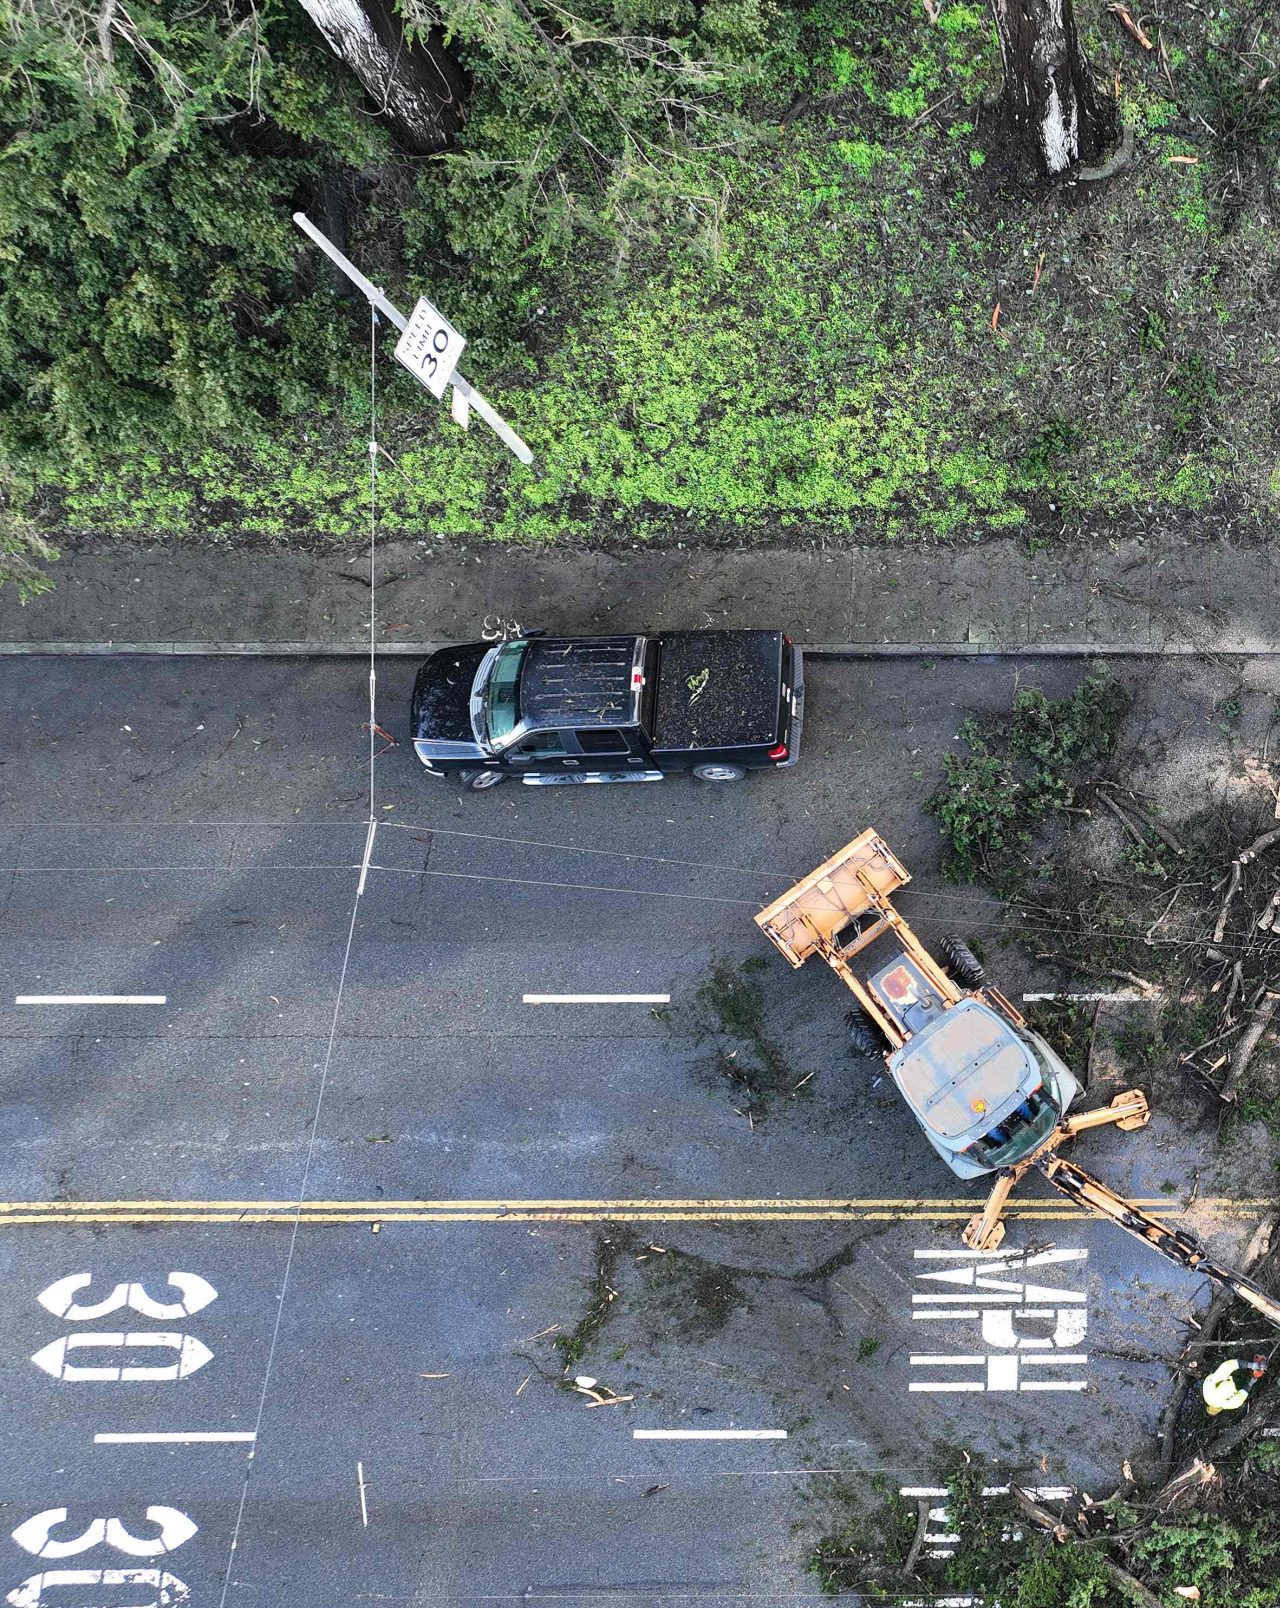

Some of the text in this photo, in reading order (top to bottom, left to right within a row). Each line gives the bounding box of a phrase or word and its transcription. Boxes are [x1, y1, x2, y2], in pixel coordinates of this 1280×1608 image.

[403, 310, 427, 354] SPEED
[413, 324, 433, 359] LIMIT
[421, 329, 449, 378] 30
[31, 1271, 218, 1381] 30
[909, 1249, 1088, 1391] MPH
[6, 1505, 199, 1608] 30
